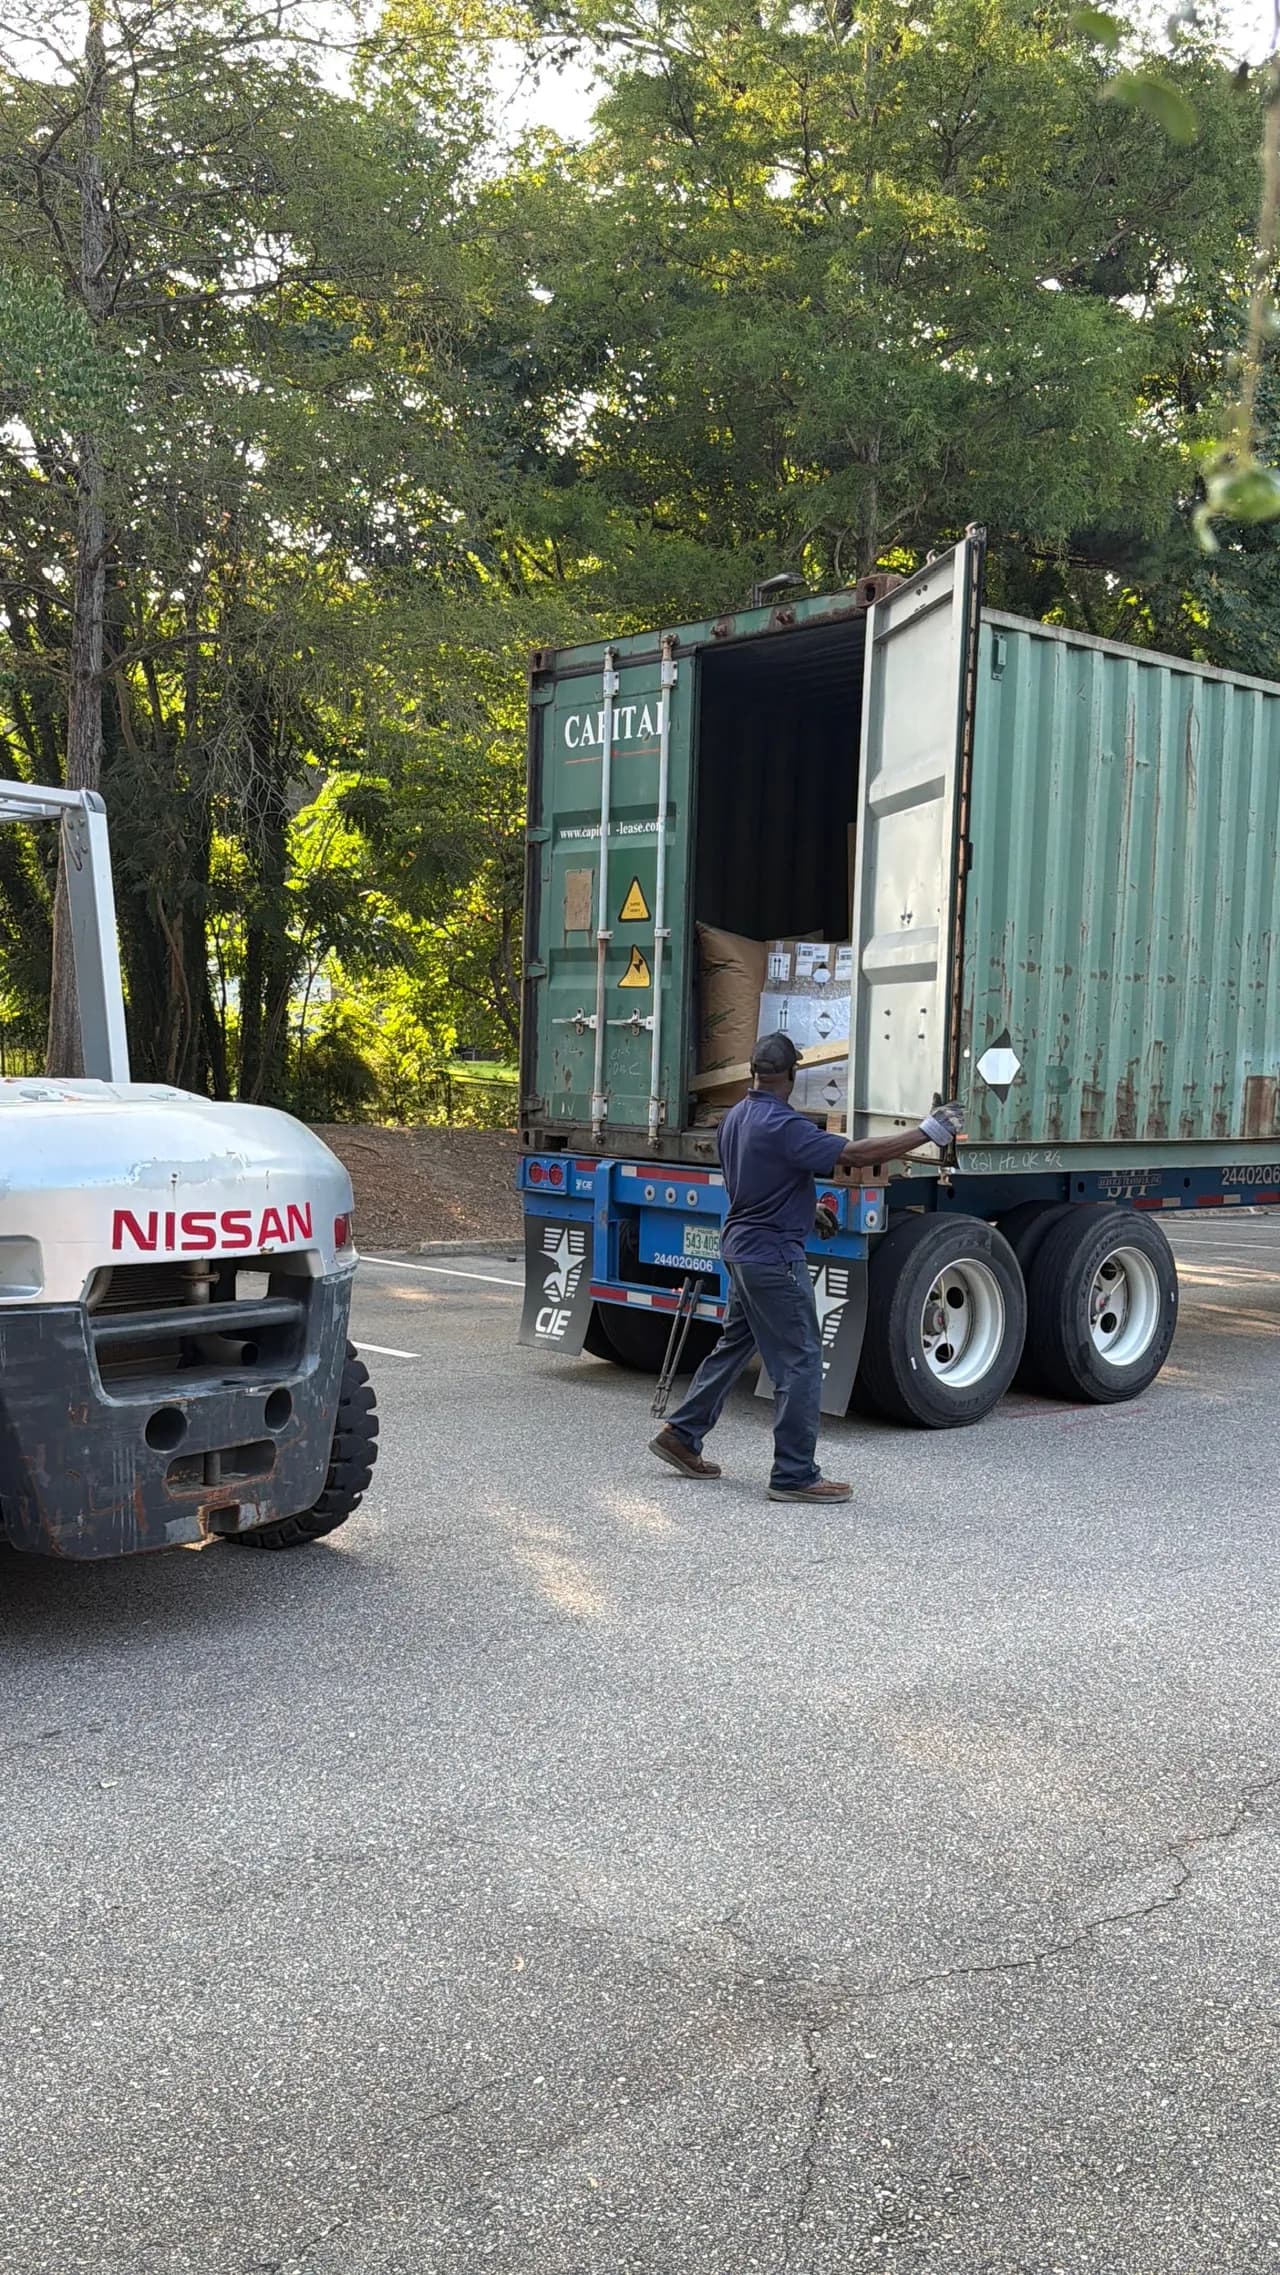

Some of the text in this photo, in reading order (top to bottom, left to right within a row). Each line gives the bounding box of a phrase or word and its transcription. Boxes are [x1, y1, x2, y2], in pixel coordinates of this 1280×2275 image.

[112, 1202, 313, 1251] NISSAN
[654, 1252, 713, 1272] 24402Q606
[535, 1306, 572, 1336] CIE
